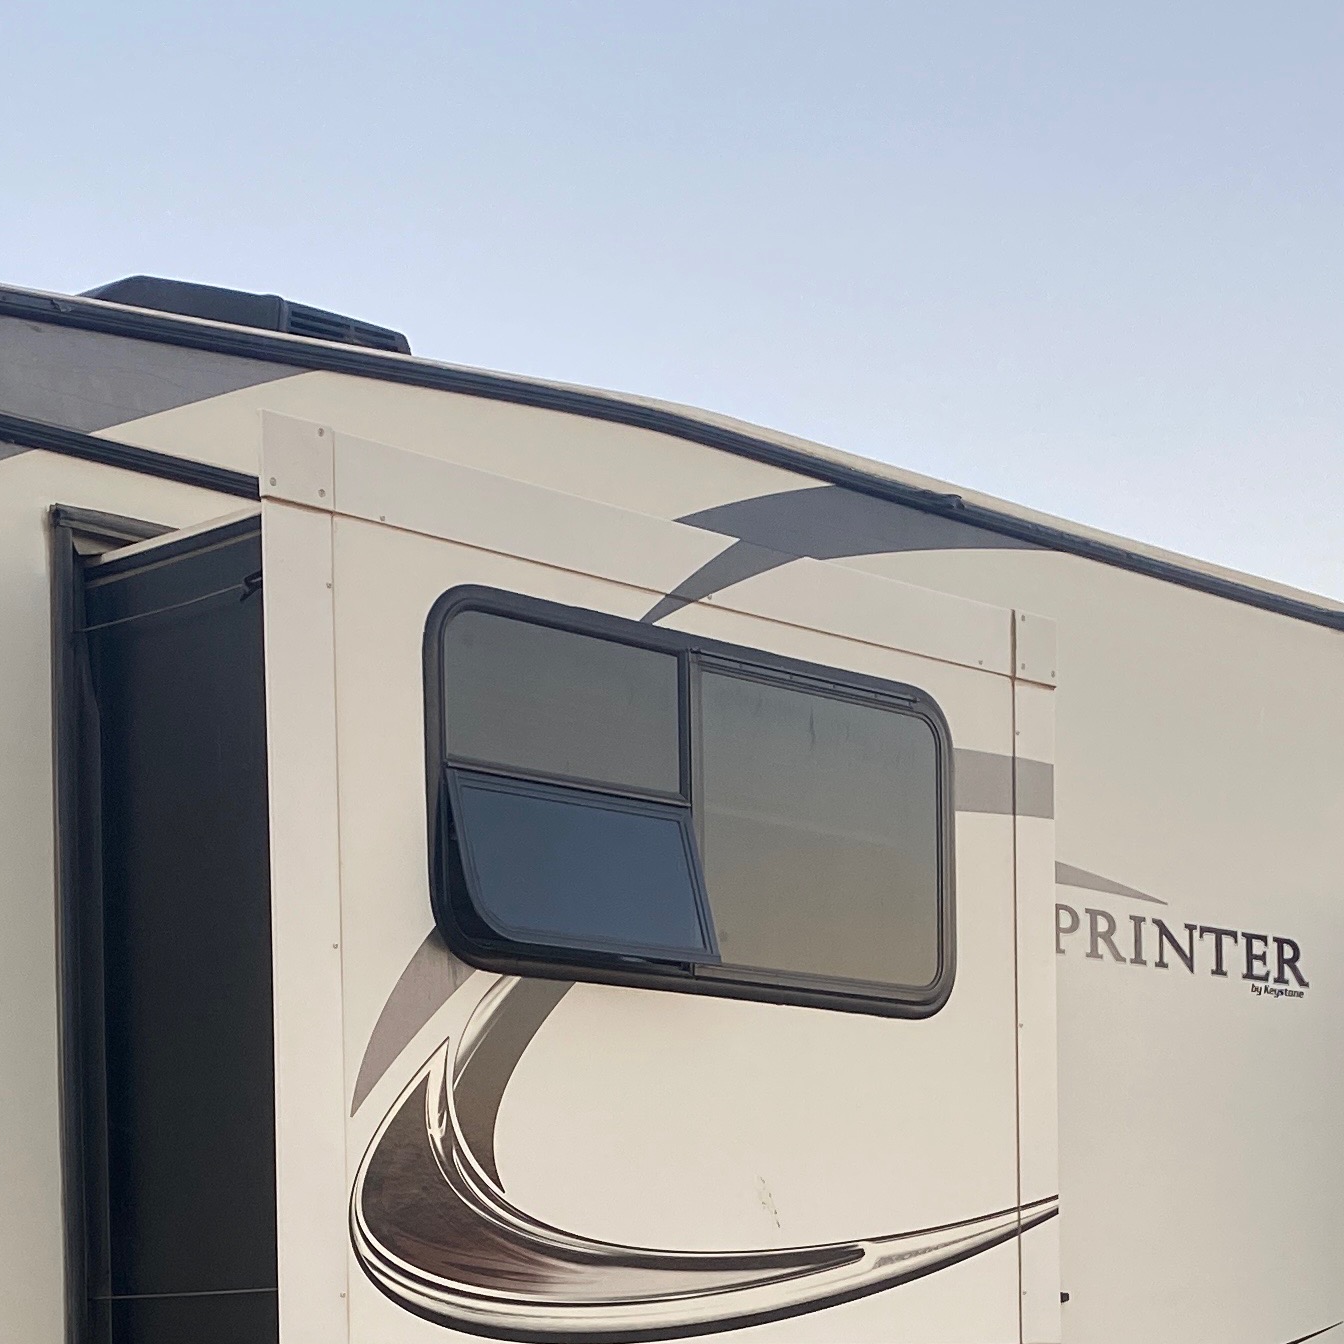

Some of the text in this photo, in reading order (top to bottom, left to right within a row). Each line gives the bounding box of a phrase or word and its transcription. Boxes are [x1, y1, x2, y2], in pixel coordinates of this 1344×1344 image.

[1054, 902, 1310, 988] PRINTER
[1250, 983, 1305, 999] by Keystone
